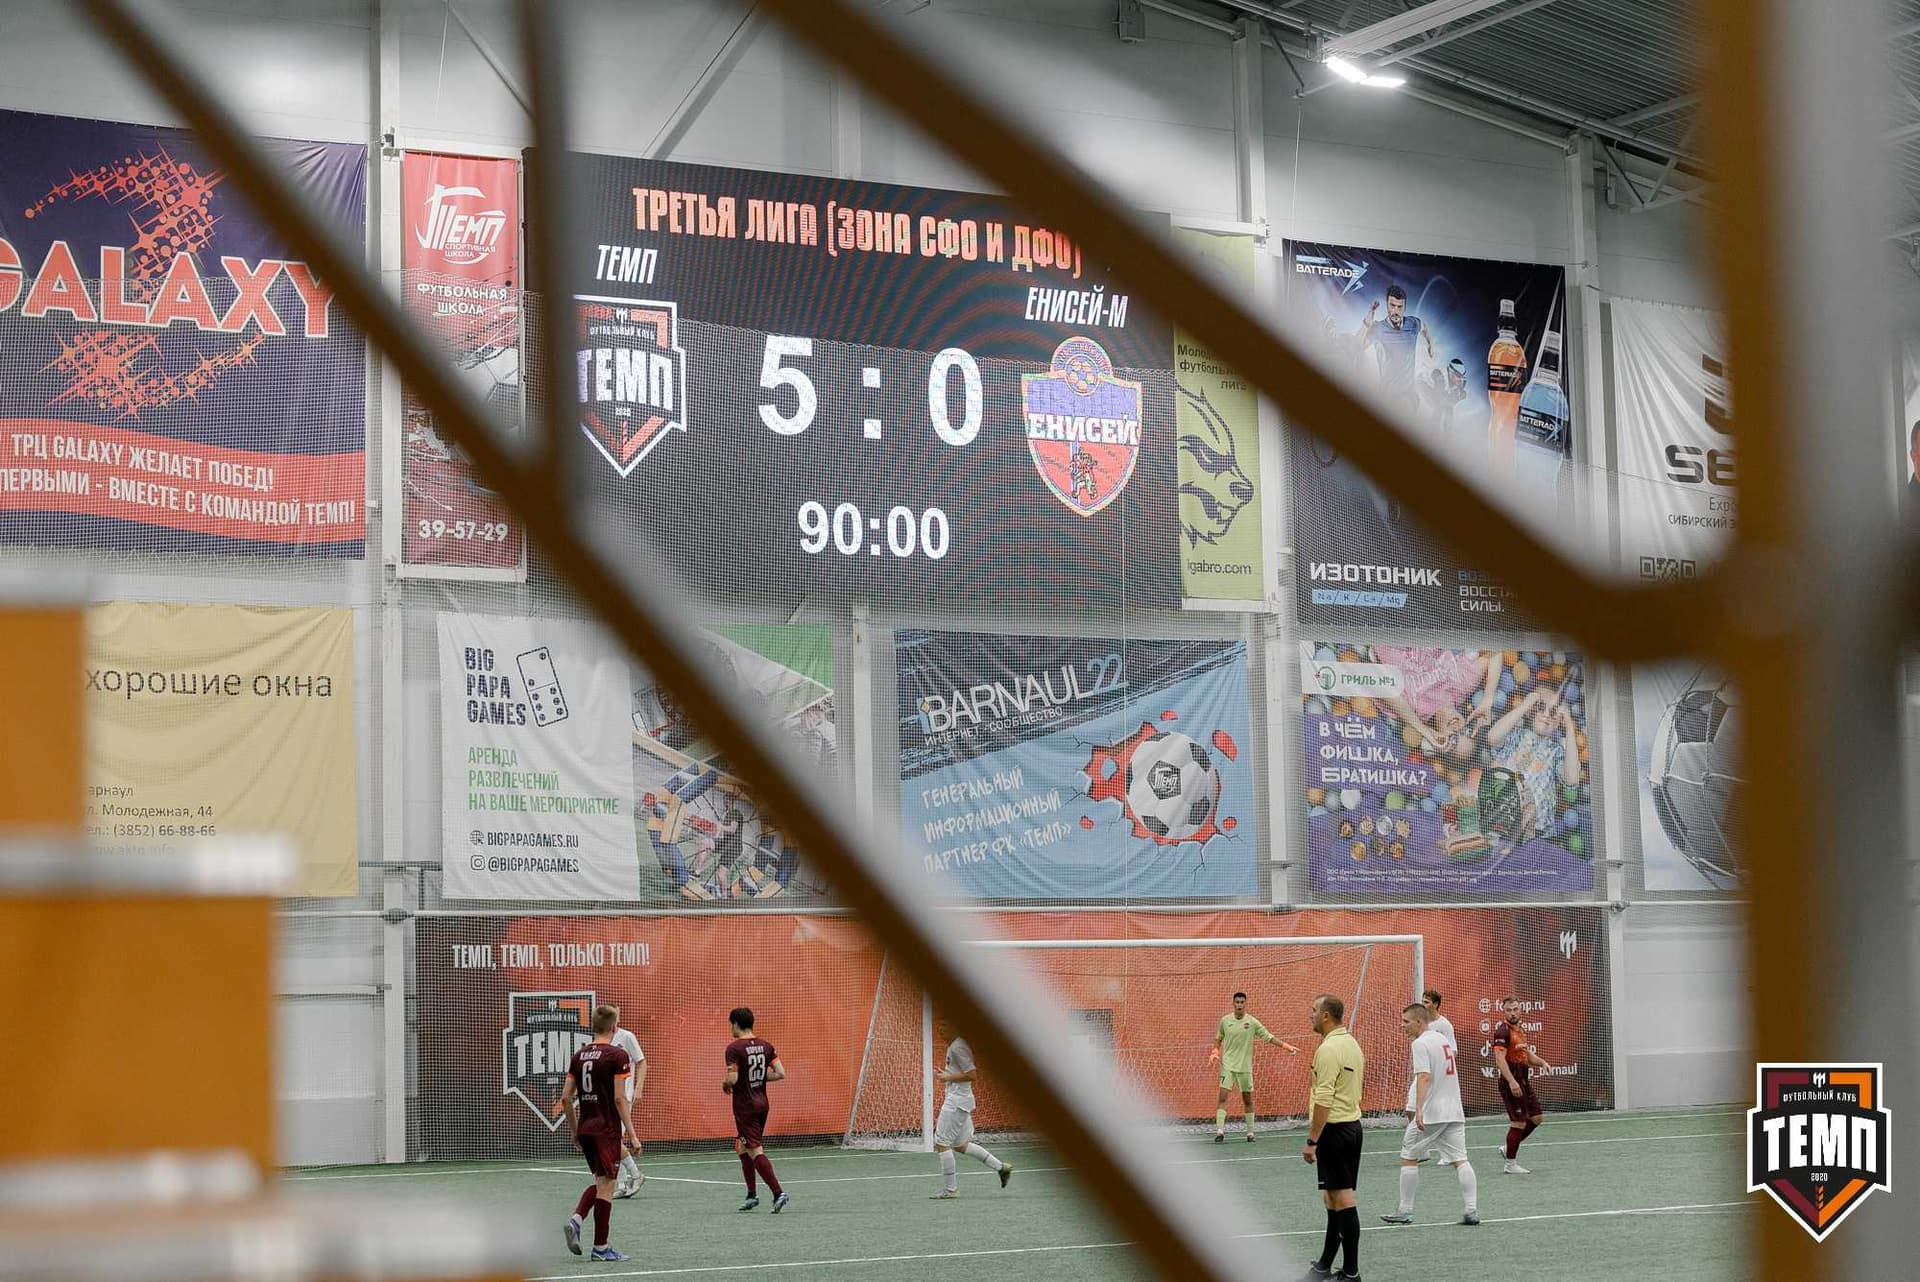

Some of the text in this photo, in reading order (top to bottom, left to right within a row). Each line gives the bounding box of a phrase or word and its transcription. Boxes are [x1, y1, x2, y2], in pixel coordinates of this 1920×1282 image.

[632, 187, 1081, 279] ТРЕТЬЯ ЛИГА (ЗОНА СФО И ДФО)
[445, 243, 496, 252] СПОРТИВНАЯ
[445, 250, 475, 258] ШКОЛА
[596, 244, 658, 285] ТЕМП
[1296, 263, 1361, 278] BATTERADE
[0, 237, 336, 338] ALAXY
[417, 283, 507, 300] ФУТБОЛЬНАЯ
[437, 301, 484, 315] ШКОЛА
[1024, 284, 1129, 328] ЕНИСЕЙ-М
[576, 348, 673, 411] ТЕМП
[759, 335, 818, 436] 5
[928, 347, 984, 446] 0
[1221, 380, 1247, 390] лига
[1027, 411, 1139, 446] ЕНИСЕЙ
[12, 433, 274, 493] ТРЦ GALAXY ЖЕЛАЕТ ПОБЕД!
[0, 468, 90, 495] ПЕРВЫМИ
[109, 475, 180, 510] ВМЕСТЕ
[184, 490, 196, 513] С
[201, 493, 300, 525] КОМАНДОЙ
[305, 501, 356, 525] ТЕМП!
[418, 519, 509, 541] 39-57-29
[798, 500, 950, 559] 90:00
[1668, 513, 1728, 529] СИБИРСКИЙ
[1310, 562, 1442, 587] ИЗОТОНИК
[1460, 600, 1505, 612] СИЛЫ.
[465, 647, 494, 672] BIG
[85, 669, 333, 700] хорошие окна
[466, 673, 511, 699] PAPA
[1341, 673, 1396, 687] ГРИЛЬ №1
[467, 700, 527, 726] GAMES
[924, 725, 979, 746] ИНТЕРНЕТ
[989, 706, 1063, 732] СООБЩЕСТВО
[1319, 716, 1376, 739] В ЧЁМ
[468, 747, 518, 767] АРЕНДА
[1320, 745, 1399, 766] ФИШКА,
[468, 769, 560, 790] РАЗВЛЕЧЕНИЙ
[922, 765, 1024, 809] ГЕНЕРАЛЬНЫЙ
[1321, 767, 1427, 786] БРАТИШКА?
[87, 786, 134, 798] арнаул
[469, 793, 620, 815] НА ВАШЕ МЕРОПРИЯТИЕ
[101, 803, 194, 819] Молодежная,
[197, 805, 214, 817] 44
[923, 787, 1062, 844] ИНФОРМАЦИОННЫЙ
[113, 823, 155, 837] (3852)
[159, 824, 217, 837] 66-88-66
[487, 832, 579, 848] BIGPAPAGAMES.RU
[923, 821, 1072, 873] ПАРТНЕР ФК «ТЕМП»
[488, 856, 579, 873] @BIGPAPAGAMES
[452, 942, 650, 971] ТЕМП, ТЕМП, ТОЛЬКО ТЕМП!
[747, 1053, 766, 1082] 23
[1442, 1044, 1455, 1075] 5
[582, 1060, 594, 1093] 6
